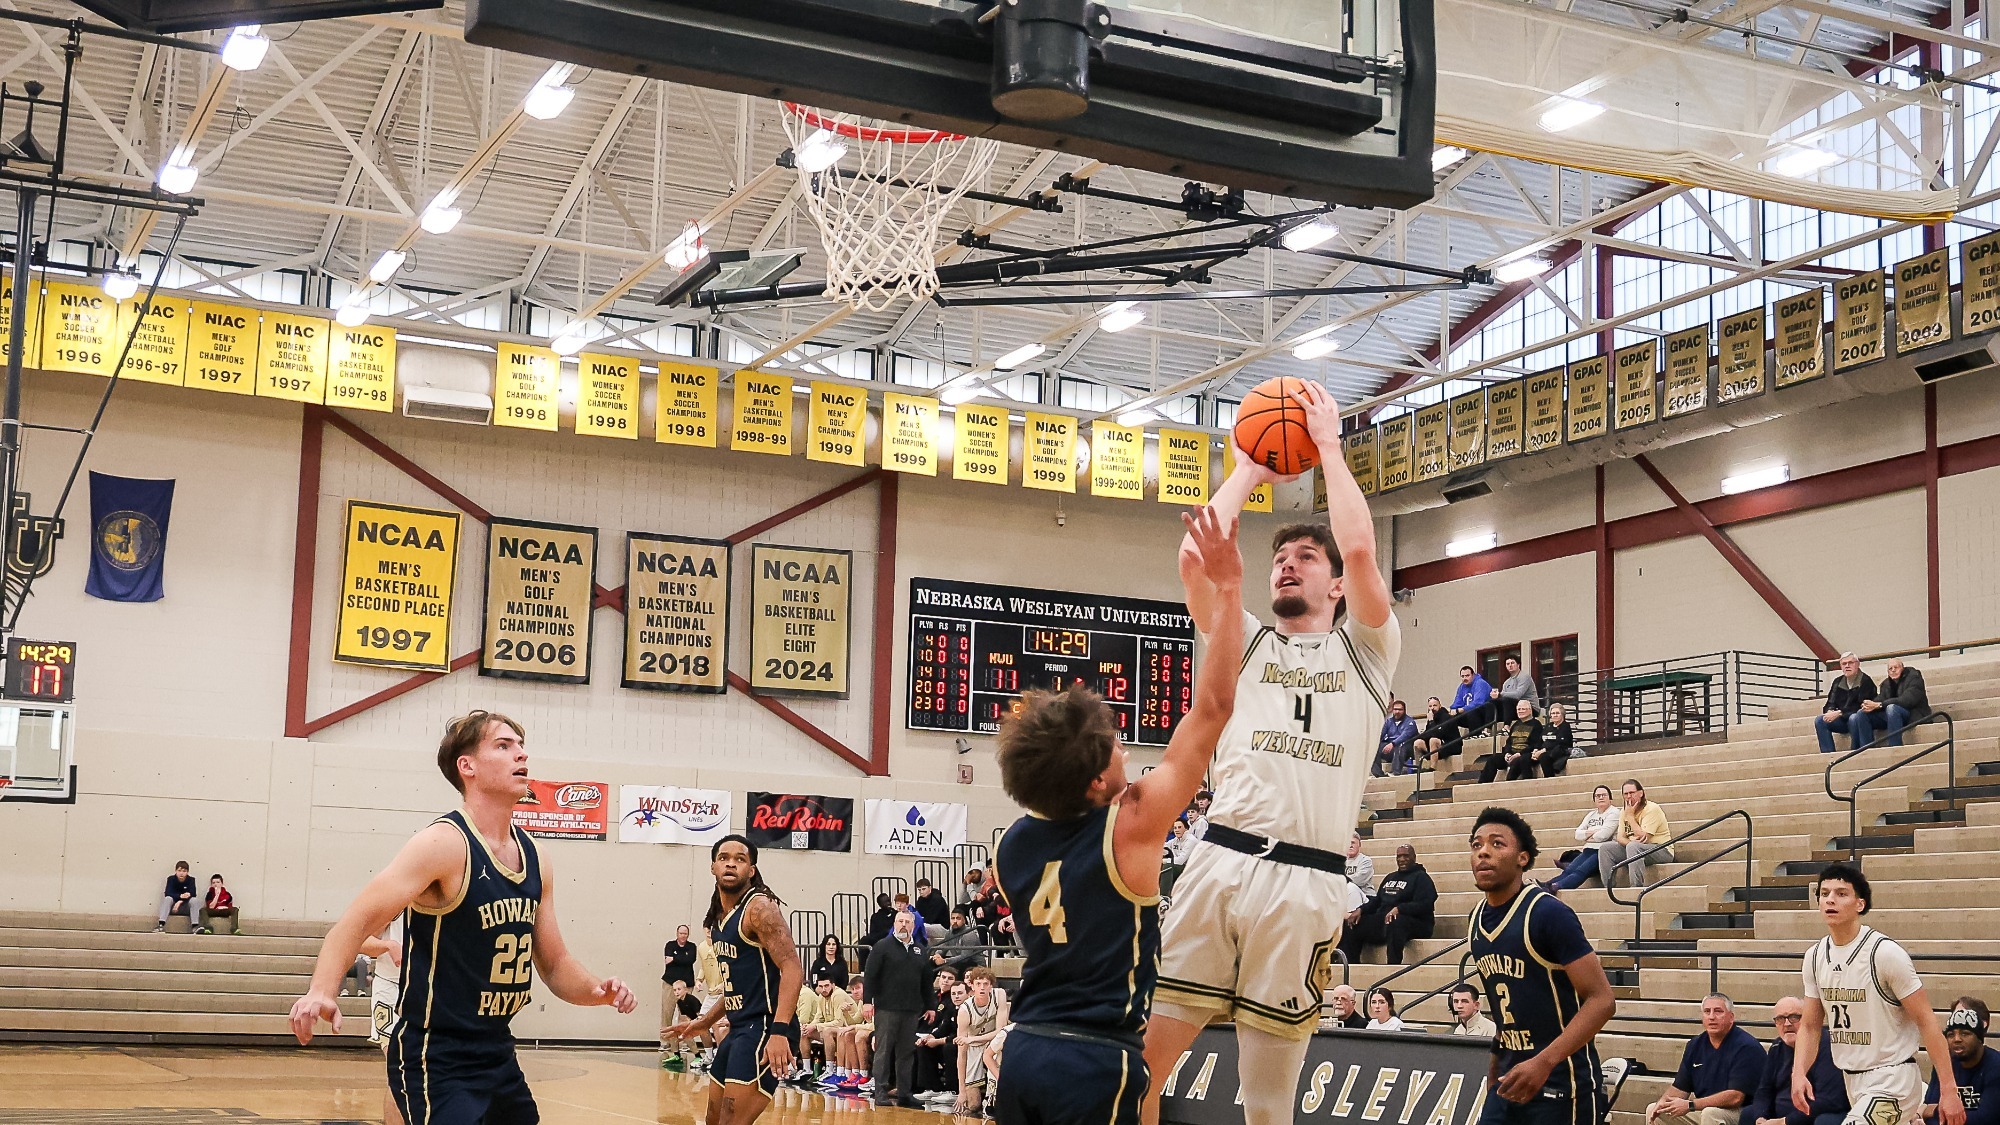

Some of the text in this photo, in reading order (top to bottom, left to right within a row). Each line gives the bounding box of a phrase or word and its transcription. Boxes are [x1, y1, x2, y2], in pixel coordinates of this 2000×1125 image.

[1901, 259, 1941, 282] GPAC
[1840, 279, 1878, 300] GPAC
[60, 293, 102, 310] NIAC
[1781, 297, 1816, 318] GPAC
[1848, 303, 1869, 315] MEN'S
[205, 312, 246, 330] NIAC
[1724, 317, 1757, 338] GPAC
[1851, 315, 1867, 326] GOLF
[211, 332, 236, 344] MEN'S
[275, 322, 316, 340] NIAC
[1841, 323, 1877, 340] CHAMPIONS
[345, 332, 385, 349] NIAC
[1670, 335, 1701, 354] GPAC
[56, 349, 101, 365] 1996
[199, 351, 245, 366] CHAMPIONS
[278, 350, 308, 363] SOCCER
[1620, 349, 1650, 368] GPAC
[1841, 341, 1877, 362] 2007
[270, 360, 314, 374] CHAMPIONS
[592, 363, 628, 379] NIAC
[1574, 362, 1602, 380] GPAC
[1782, 357, 1816, 379] 2006
[199, 367, 242, 385] 1997
[270, 376, 312, 393] 1997
[339, 370, 384, 383] CHAMPIONS
[671, 372, 706, 388] NIAC
[592, 380, 625, 393] WOMEN'S
[747, 381, 781, 397] NIAC
[1531, 377, 1558, 393] GPAC
[333, 386, 388, 403] 1997-98
[594, 390, 622, 402] SOCCER
[676, 390, 699, 401] MEN'S
[820, 392, 856, 408] NIAC
[1491, 388, 1518, 404] GPAC
[506, 406, 547, 422] 1998
[587, 399, 629, 412] CHAMPIONS
[1455, 399, 1480, 415] GPAC
[1620, 404, 1650, 423] 2005
[587, 414, 628, 431] 1998
[666, 408, 707, 421] CHAMPIONS
[743, 415, 782, 428] CHAMPIONS
[966, 413, 999, 428] NIAC
[1418, 411, 1444, 428] GPAC
[667, 423, 706, 439] 1998
[817, 425, 857, 439] CHAMPIONS
[1035, 421, 1067, 436] NIAC
[1573, 417, 1601, 434] 2004
[736, 430, 788, 446] 1998-99
[1102, 430, 1133, 444] NIAC
[1169, 437, 1199, 452] NIAC
[1531, 430, 1558, 447] 2002
[818, 440, 853, 456] 1999
[963, 447, 999, 459] CHAMPIONS
[893, 452, 927, 467] 1999
[1032, 455, 1068, 467] CHAMPIONS
[964, 461, 997, 476] 1999
[1033, 469, 1066, 483] 1999
[1167, 470, 1200, 482] CHAMPIONS
[1419, 461, 1443, 476] 2001
[1094, 477, 1141, 493] 1999-2000
[1384, 470, 1408, 486] 2000
[1166, 484, 1201, 498] 2000
[356, 520, 446, 552] NCAA
[498, 536, 584, 566] NCAA
[377, 560, 422, 578] MEN'S
[637, 551, 719, 579] NCAA
[763, 559, 841, 585] NCAA
[520, 567, 561, 583] MEN'S
[355, 576, 440, 600] BASKETBALL
[524, 585, 555, 601] GOLF
[658, 581, 697, 597] MEN'S
[782, 589, 820, 604] MEN'S
[346, 594, 446, 618] SECOND PLACE
[506, 601, 570, 620] NATIONAL
[638, 597, 715, 615] BASKETBALL
[765, 604, 837, 622] BASKETBALL
[916, 588, 1192, 630] NEBRASKA WESLEYAN UNIVERSITY
[499, 617, 575, 637] CHAMPIONS
[645, 613, 706, 631] NATIONAL
[785, 622, 816, 637] ELITE
[919, 620, 967, 632] PLYR FLS PTS
[357, 625, 432, 654] 1997
[639, 630, 713, 649] CHAMPIONS
[783, 638, 817, 653] EIGHT
[925, 634, 969, 652] 4 0 0
[1033, 630, 1087, 655] 14:29
[20, 644, 71, 665] 14:29
[494, 638, 577, 667] 2006
[919, 648, 968, 666] 10 0 4
[989, 652, 1014, 666] NWU
[639, 652, 710, 677] 2018
[765, 658, 834, 682] 2024
[1045, 662, 1068, 674] PERIOD
[1099, 661, 1123, 675] HPU
[1151, 653, 1191, 670] 2 0 2
[31, 665, 61, 696] 17
[919, 665, 968, 682] 14 4
[996, 668, 1018, 691] 11
[1151, 669, 1191, 686] 3 0 4
[915, 679, 968, 697] 20 0 3
[1107, 677, 1127, 701] 12
[1150, 684, 1191, 700] 4 0
[915, 695, 967, 714] 23 0 0
[1146, 699, 1158, 712] 12
[1161, 699, 1171, 713] 0
[1142, 713, 1170, 729] 22 0
[1293, 693, 1312, 734] 4
[979, 721, 1002, 733] FOULS
[557, 785, 601, 808] Cane's
[512, 810, 538, 821] PROUD
[539, 812, 575, 823] SPONSOR
[575, 814, 586, 823] OF
[528, 819, 562, 829] WOLVES
[564, 821, 601, 831] ATHLETICS
[752, 804, 843, 832] Red Robin
[888, 827, 942, 846] ADEN
[1028, 860, 1068, 944] 4
[489, 932, 533, 985] 22
[1495, 982, 1516, 1025] 2
[1831, 1003, 1851, 1029] 23
